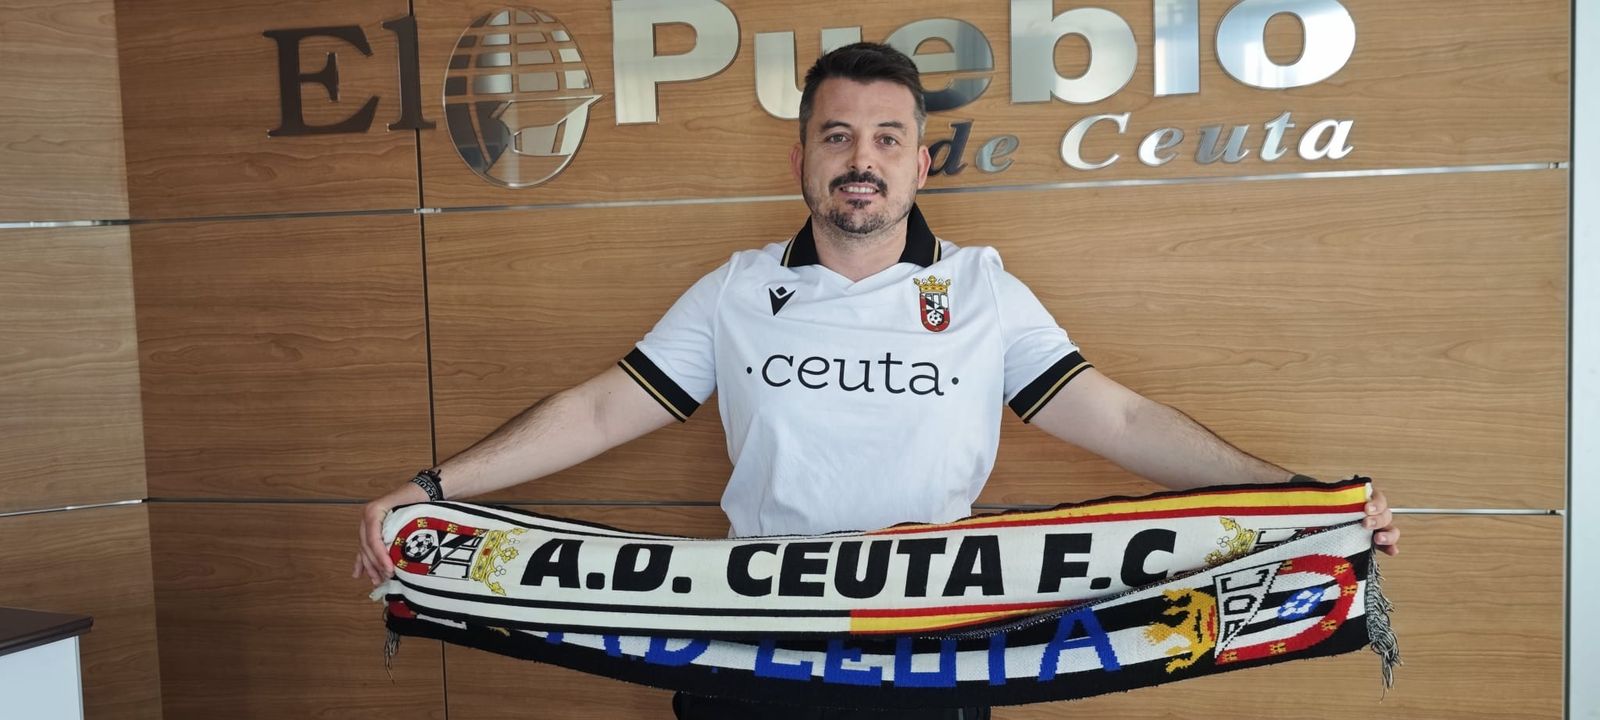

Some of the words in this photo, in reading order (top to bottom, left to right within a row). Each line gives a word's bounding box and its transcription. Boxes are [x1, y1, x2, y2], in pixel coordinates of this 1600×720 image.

[263, 15, 437, 138] El
[612, 0, 1357, 126] Pueblo
[927, 119, 1020, 176] de
[1060, 111, 1354, 170] Ceuta
[520, 539, 692, 594] A.D.
[727, 535, 1005, 598] CEUTA
